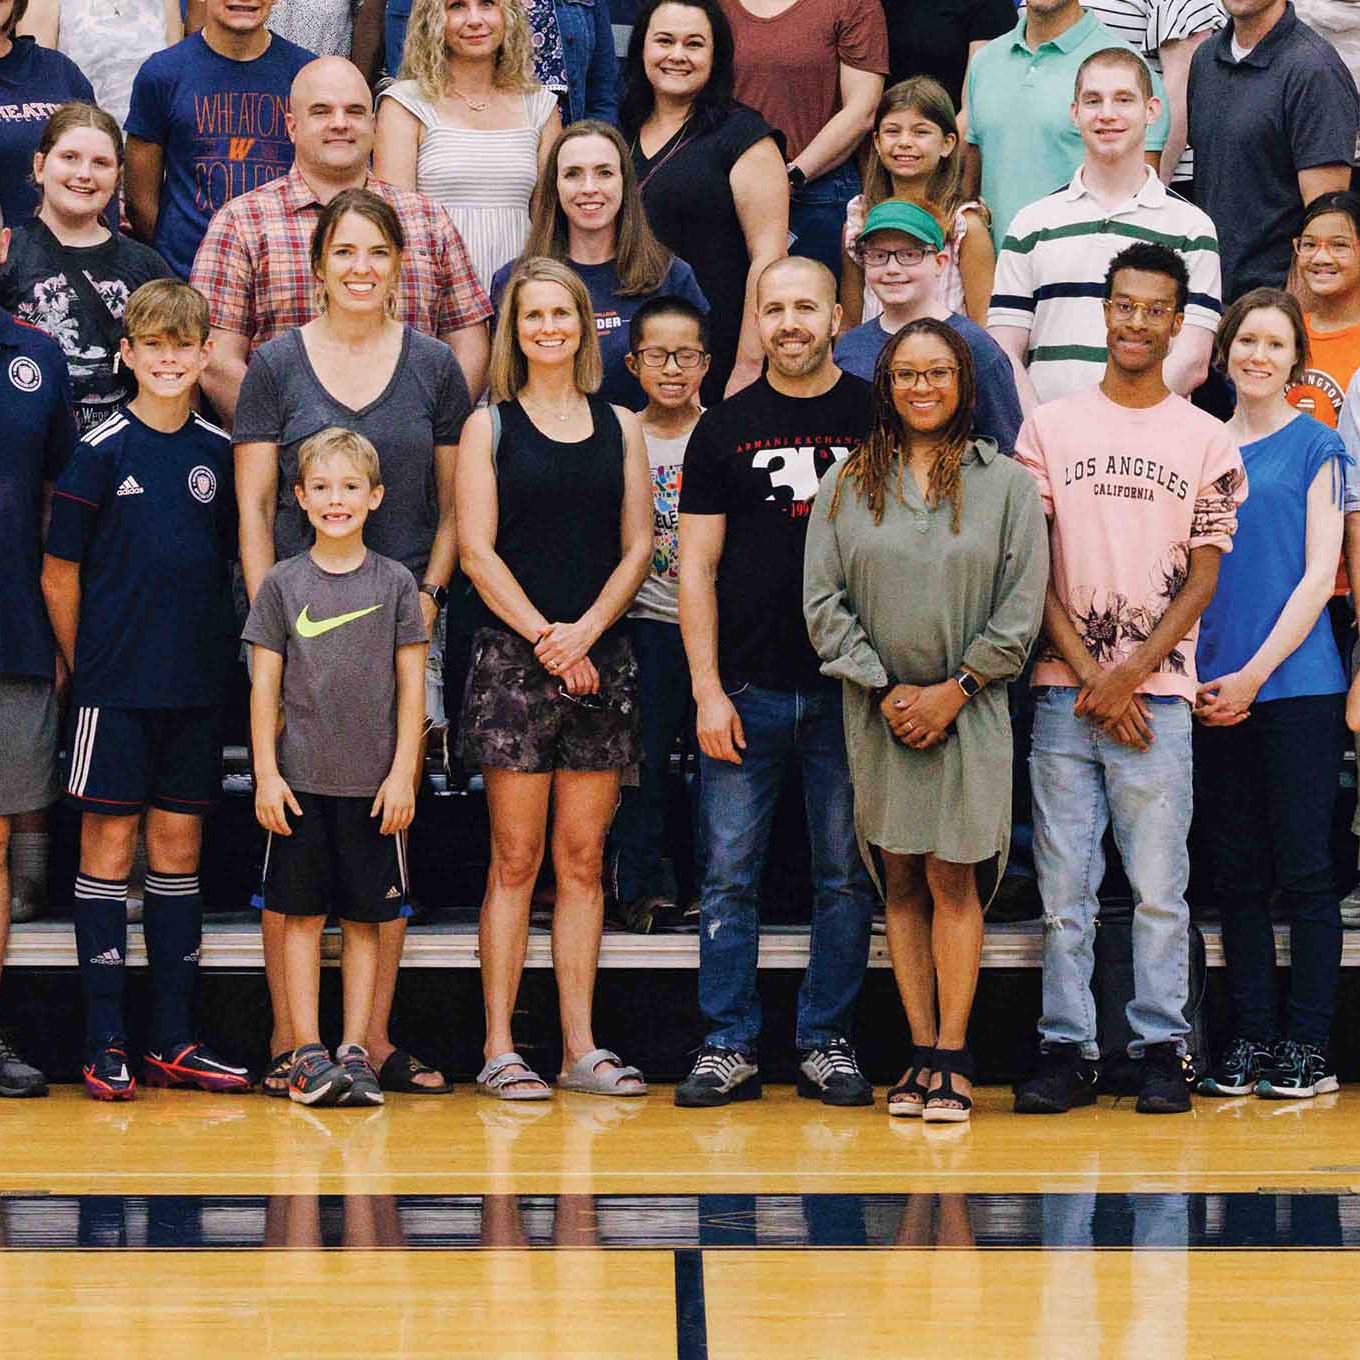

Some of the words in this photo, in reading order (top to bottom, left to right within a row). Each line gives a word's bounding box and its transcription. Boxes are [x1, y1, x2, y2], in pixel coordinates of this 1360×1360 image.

[1065, 457, 1097, 487] LOS
[1105, 455, 1190, 500] ANGELES
[116, 487, 145, 497] adidas
[1093, 483, 1155, 502] CALIFORNIA
